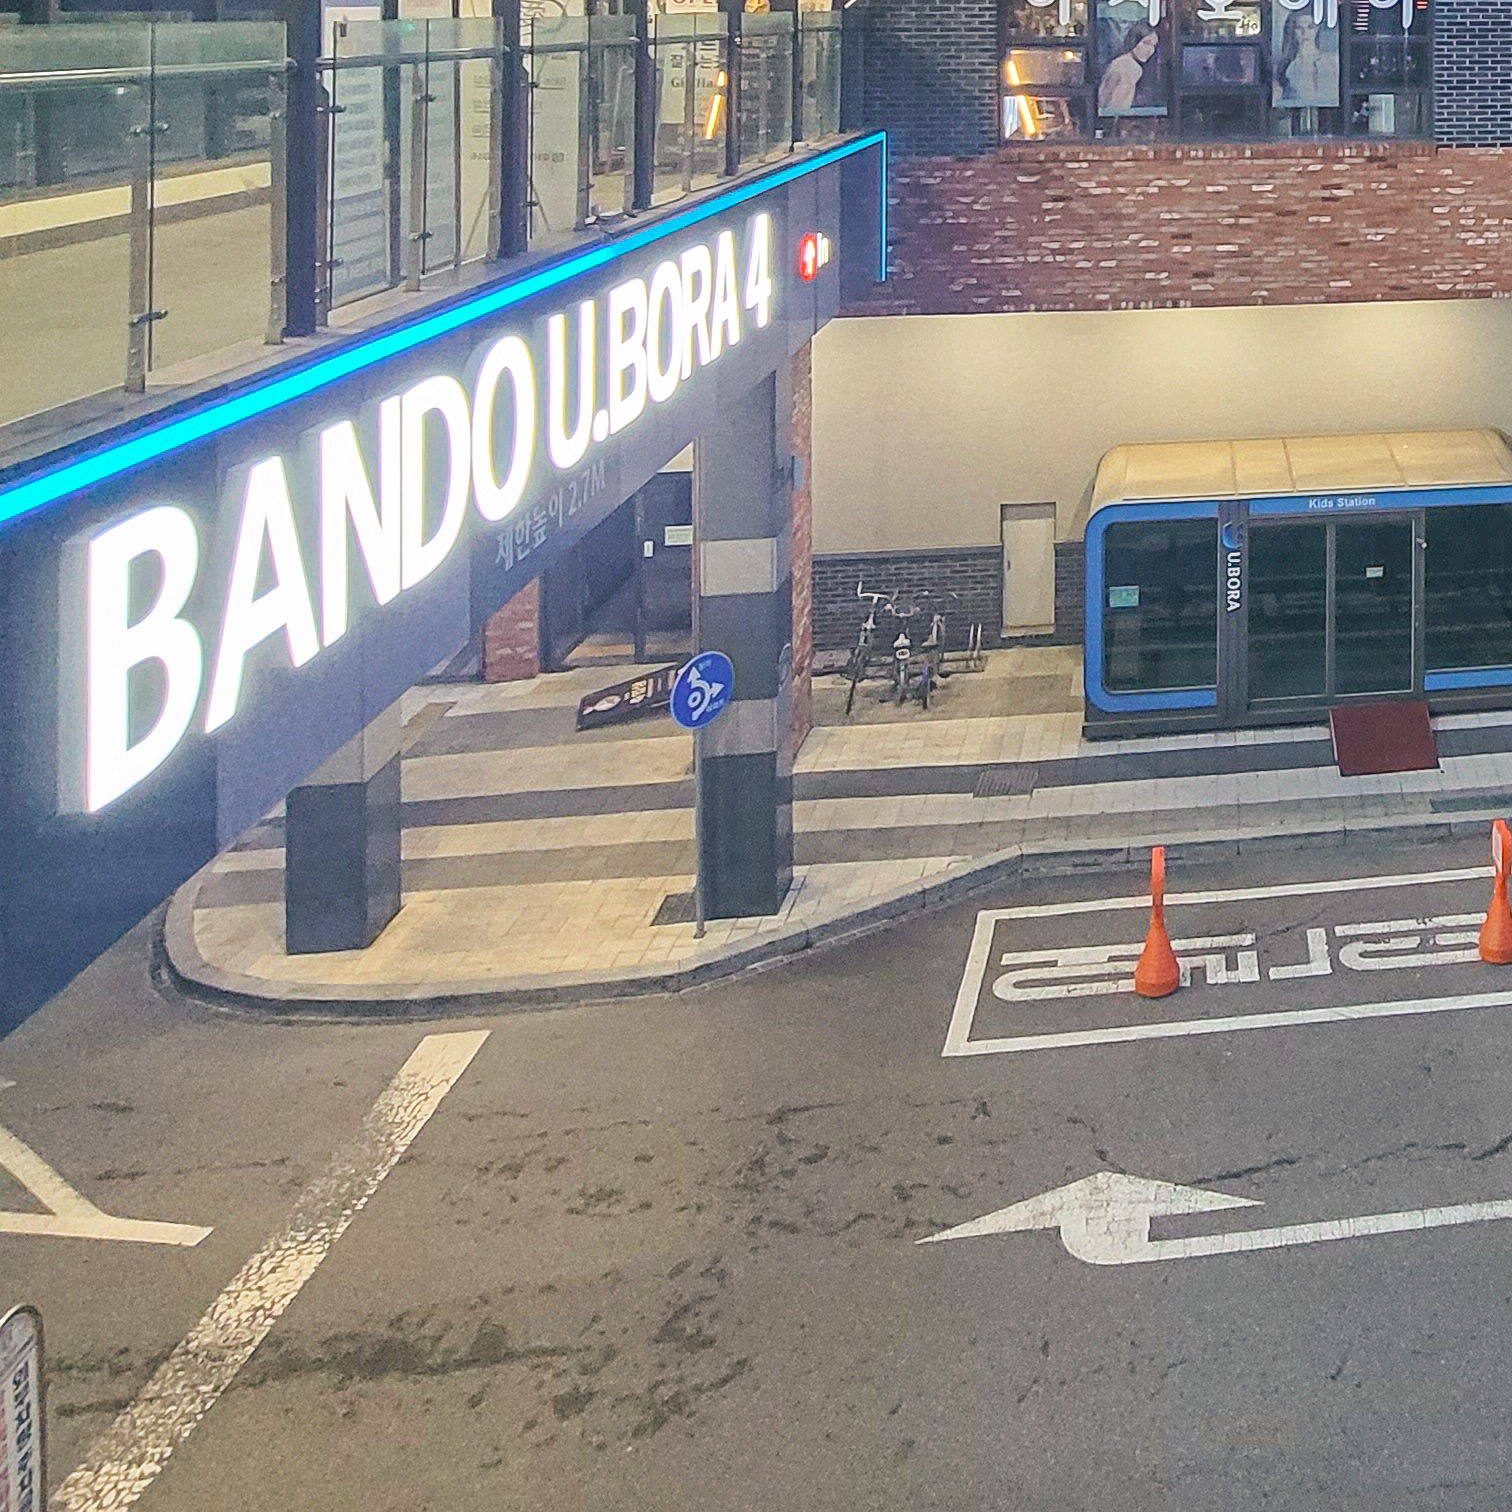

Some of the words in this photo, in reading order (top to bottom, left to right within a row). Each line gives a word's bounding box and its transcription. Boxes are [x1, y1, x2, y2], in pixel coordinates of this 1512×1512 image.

[86, 334, 537, 813] BANDO
[547, 230, 741, 470] U.BORA
[745, 213, 773, 329] 4
[495, 487, 563, 572] 제한높이
[568, 457, 605, 517] 2.7M
[1308, 498, 1334, 509] Kids
[1337, 495, 1376, 507] Station
[1226, 551, 1241, 612] U.BORA
